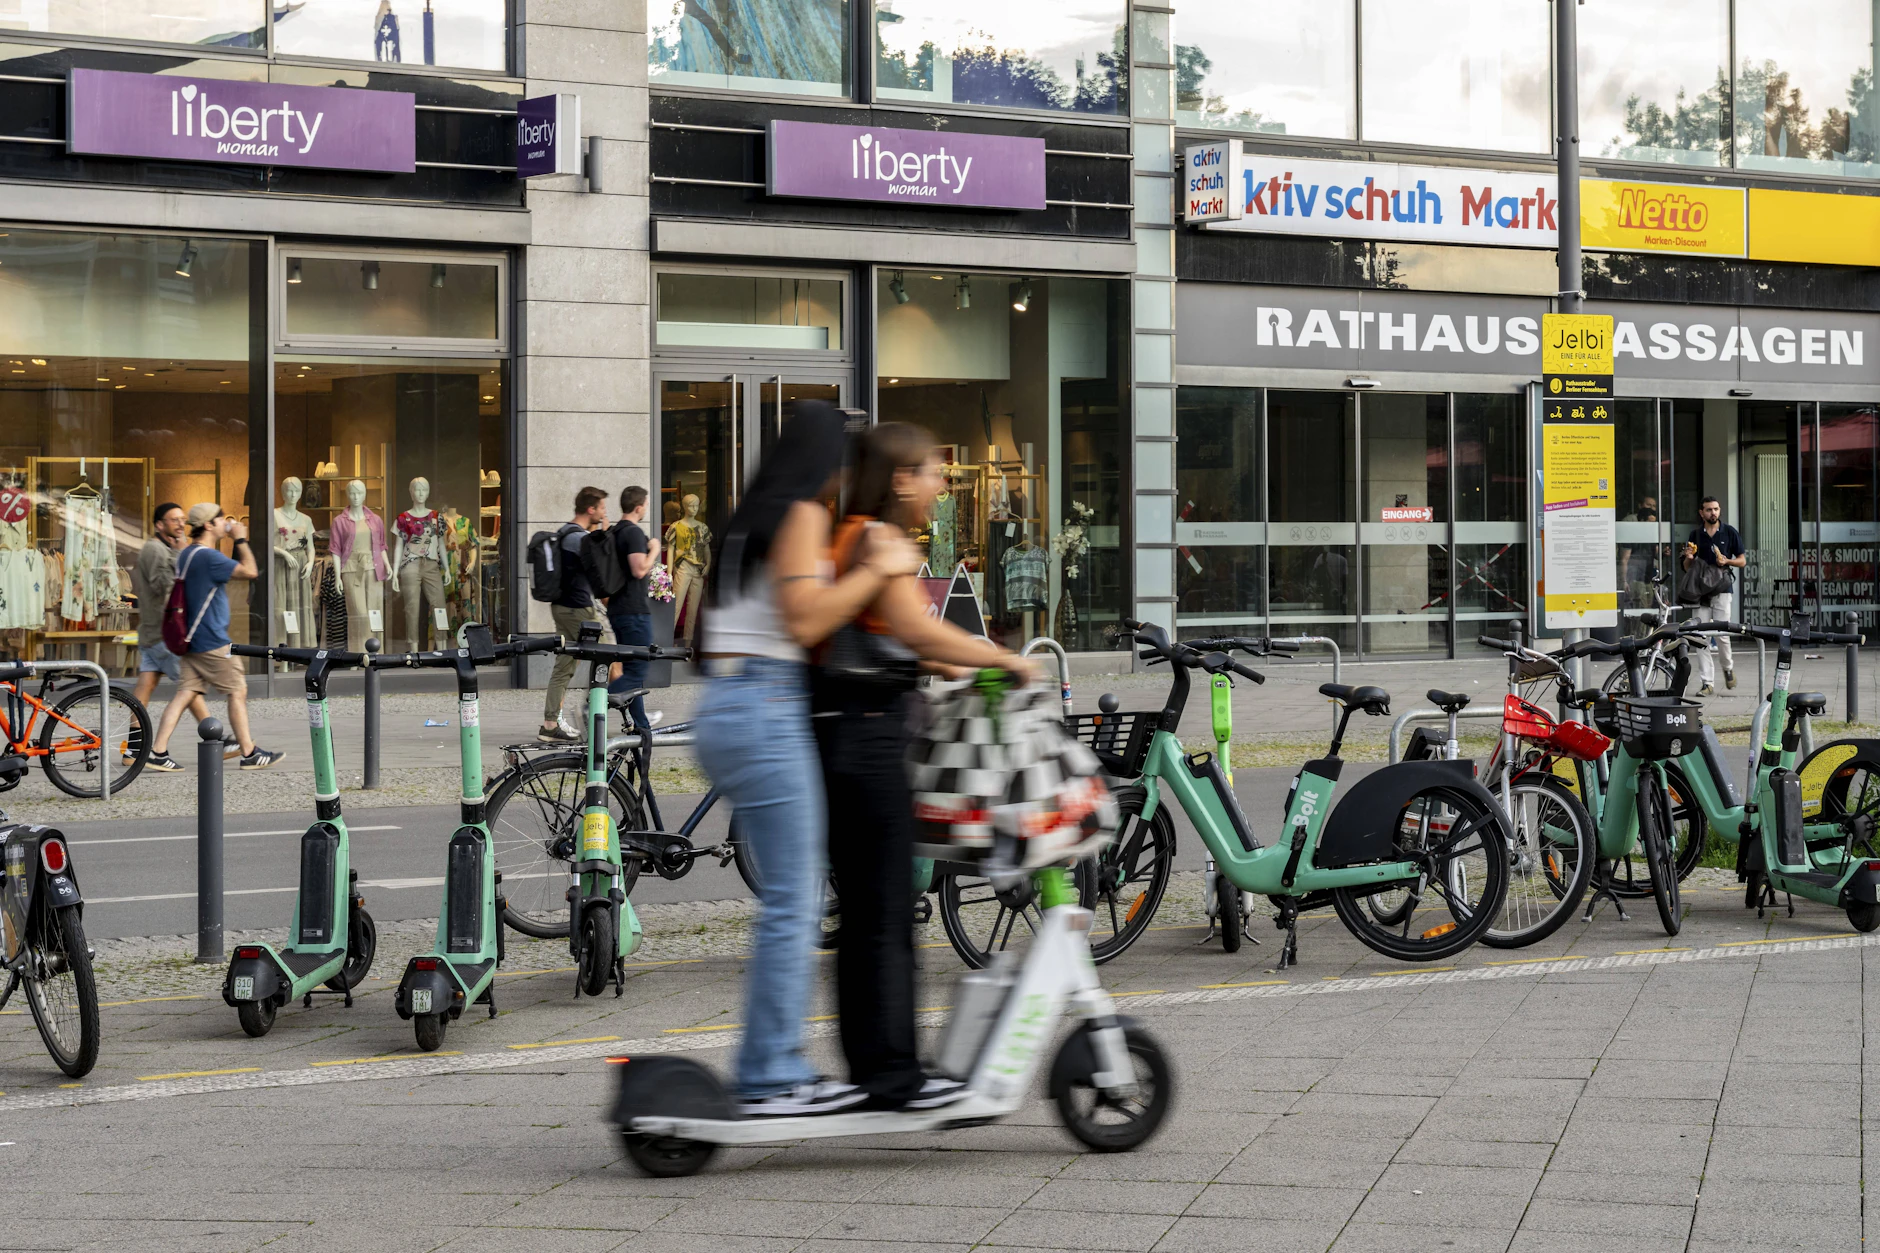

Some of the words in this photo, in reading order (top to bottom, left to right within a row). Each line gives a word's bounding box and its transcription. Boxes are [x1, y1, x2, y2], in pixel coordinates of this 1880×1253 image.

[171, 84, 324, 154] liberty
[518, 118, 555, 147] liberty
[216, 141, 279, 158] woman
[1193, 148, 1222, 168] aktiv
[852, 133, 973, 194] liberty
[887, 181, 938, 197] woman
[1190, 171, 1224, 192] schuh
[1190, 197, 1223, 216] Markt
[1242, 169, 1320, 218] ktiv
[1324, 176, 1443, 225] schuh
[1460, 184, 1558, 231] Mark
[1617, 188, 1709, 232] Netto
[1644, 235, 1707, 248] Marken-Discount
[1256, 306, 1540, 356] RATHAUS
[1612, 321, 1864, 366] ASSAGEN
[1553, 329, 1603, 350] Jelbi
[1560, 352, 1574, 360] EINE
[1575, 351, 1586, 360] FÜR
[1382, 510, 1422, 519] EINGANG
[1822, 549, 1832, 562] &
[1744, 609, 1785, 625] FRESH
[1666, 713, 1687, 727] Bolt
[1291, 790, 1319, 830] Bolt
[236, 979, 252, 988] 310
[414, 991, 430, 1000] 129
